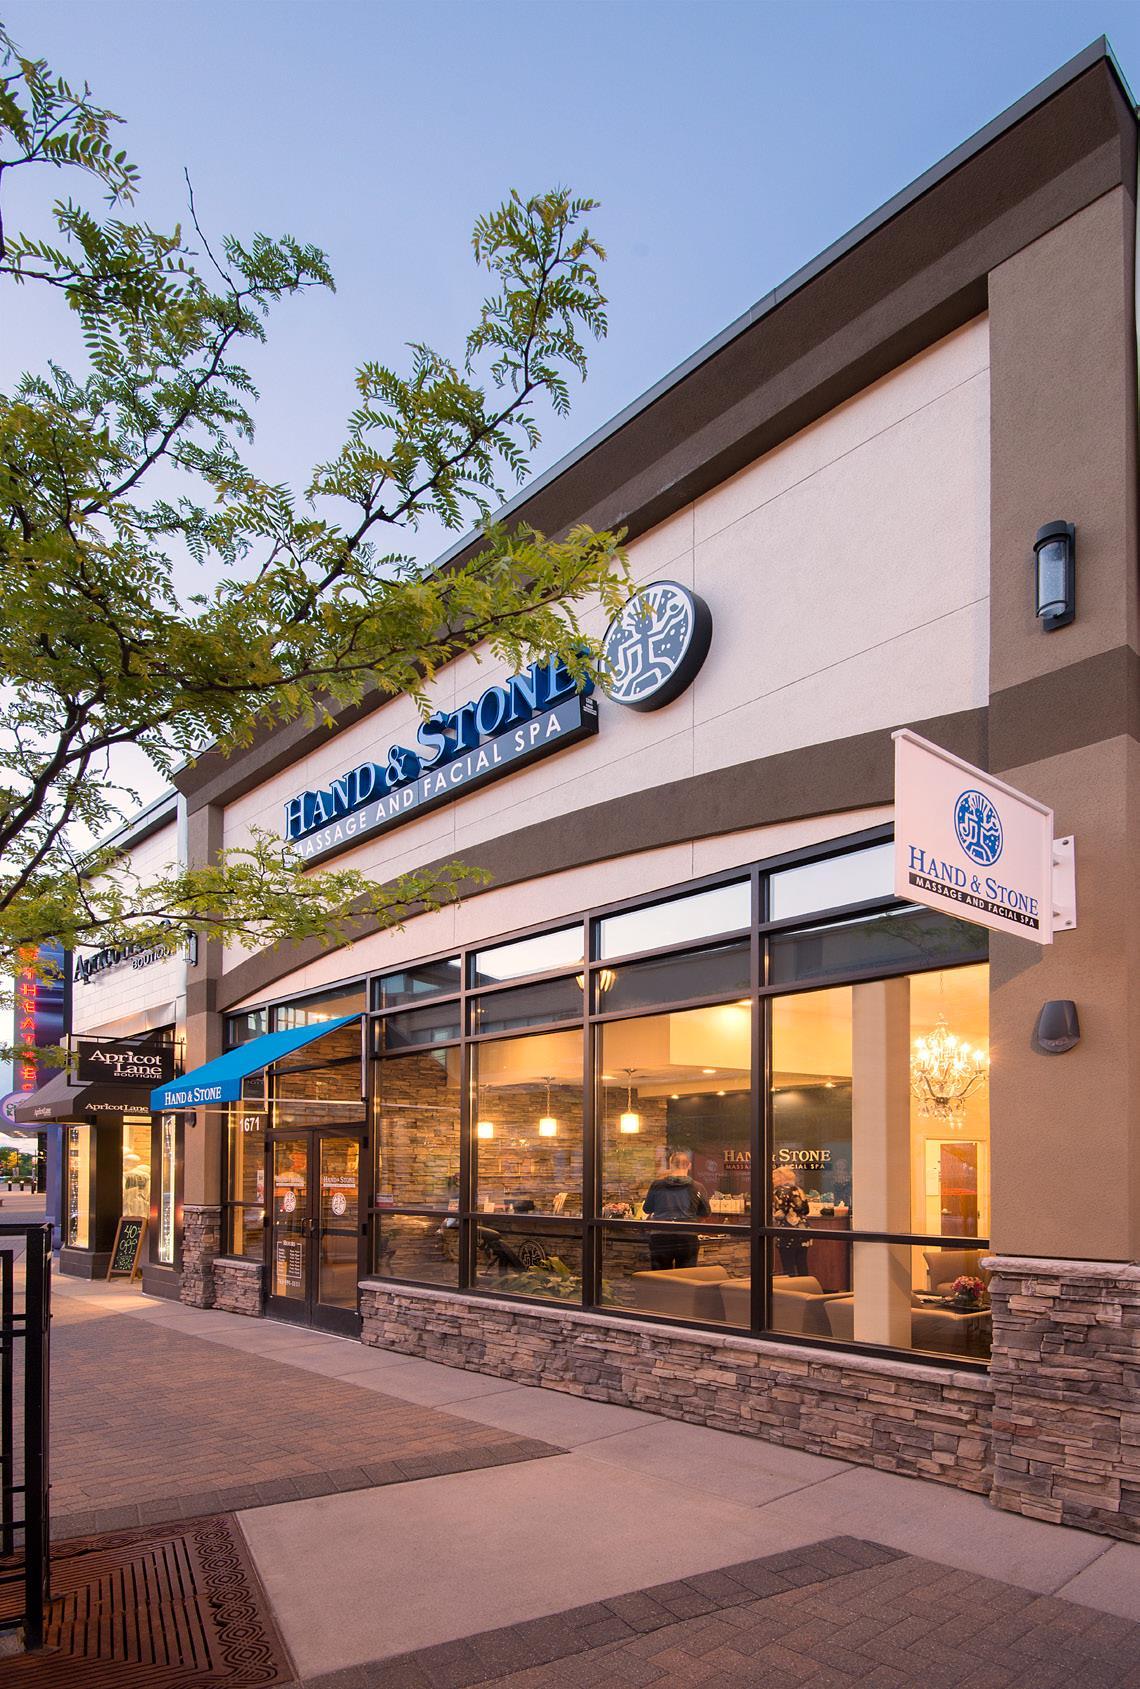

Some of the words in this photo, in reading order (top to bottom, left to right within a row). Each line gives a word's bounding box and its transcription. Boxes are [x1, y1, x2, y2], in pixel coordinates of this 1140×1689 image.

[284, 762, 377, 842] HAND
[385, 744, 409, 787] &
[417, 646, 580, 770] STONE
[375, 788, 414, 822] AND
[423, 742, 502, 798] FACIAL
[514, 713, 562, 752] SPA
[908, 844, 967, 888] HAND
[970, 874, 982, 895] &
[985, 877, 1040, 917] STONE
[915, 876, 963, 901] MASSAGE
[965, 895, 985, 909] AND
[988, 903, 1018, 921] FACIAL
[1020, 915, 1035, 927] SPA
[88, 1050, 162, 1066] Apricot
[114, 1061, 162, 1075] Lane
[164, 1091, 187, 1106] HAND
[187, 1090, 193, 1102] &
[193, 1086, 222, 1102] STONE
[240, 1116, 260, 1132] 1671
[723, 1150, 751, 1162] HAN
[779, 1148, 831, 1162] STONE
